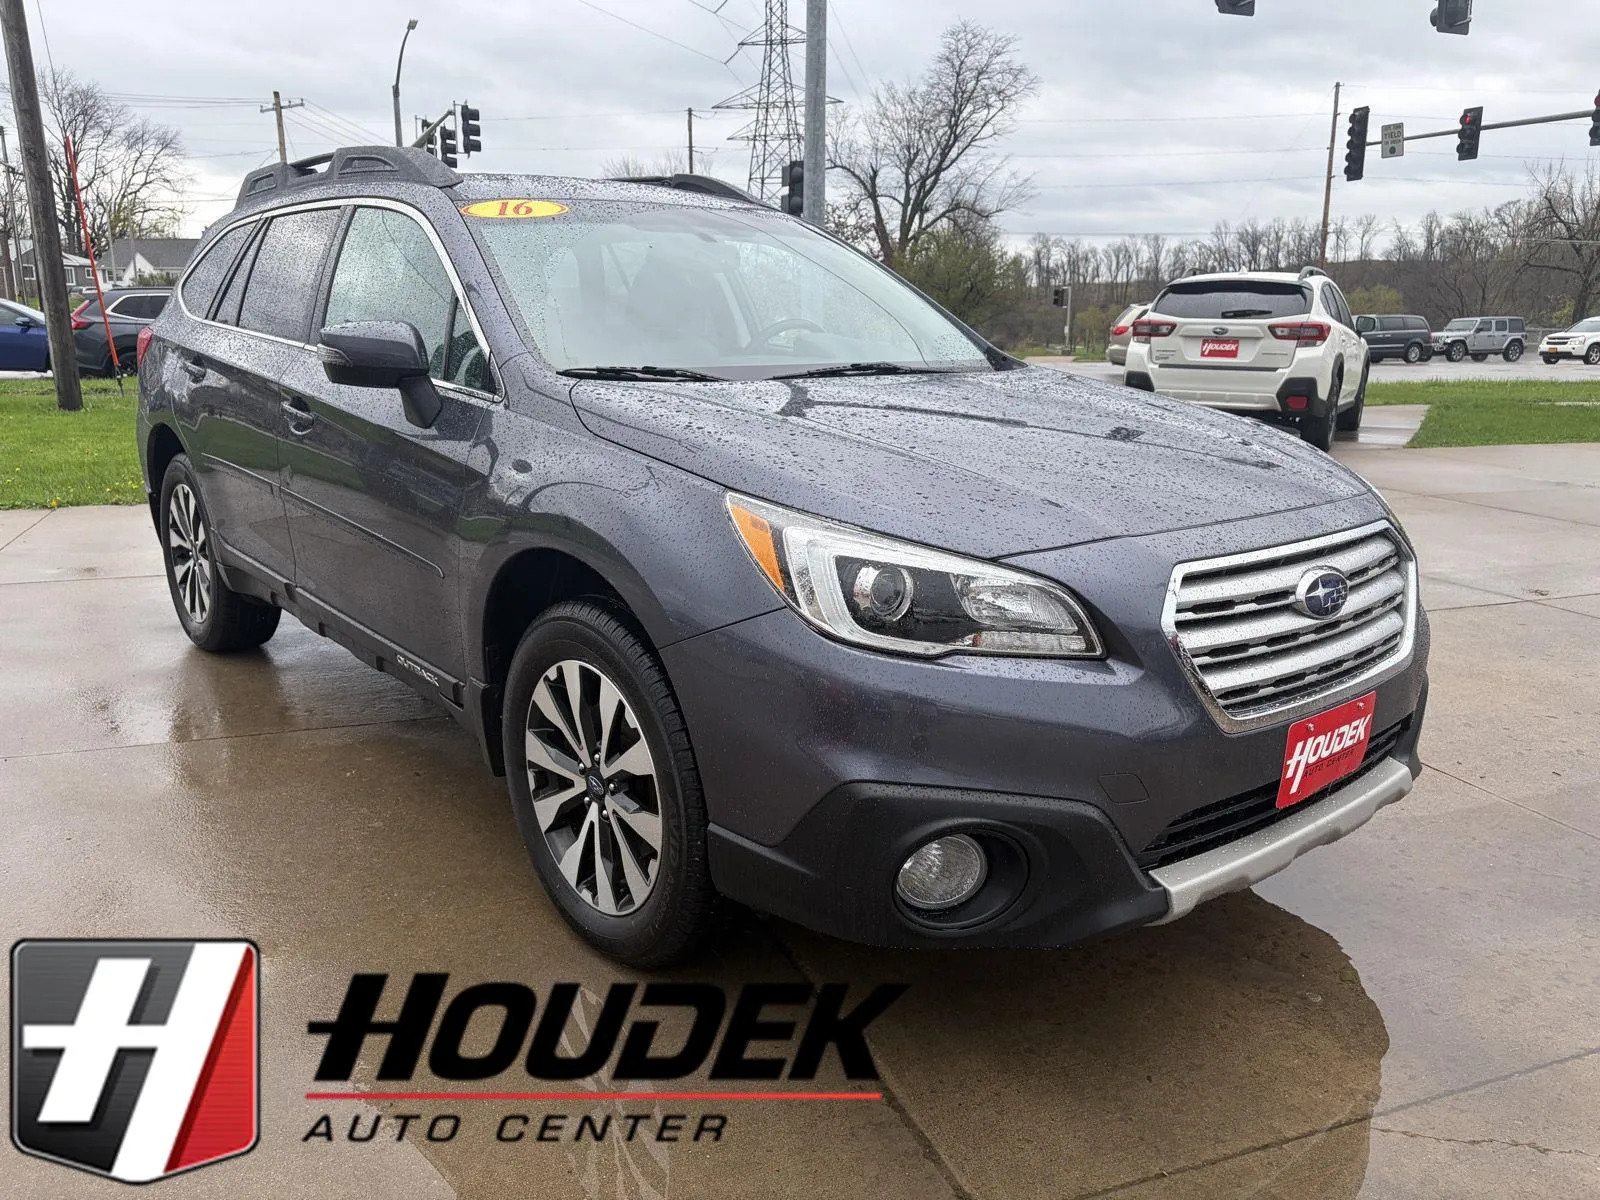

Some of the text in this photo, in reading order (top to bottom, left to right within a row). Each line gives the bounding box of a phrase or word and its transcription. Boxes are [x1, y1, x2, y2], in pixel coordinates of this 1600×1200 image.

[497, 201, 533, 216] 16
[1202, 342, 1238, 355] HOUDEK
[1285, 713, 1372, 794] HOUDEK
